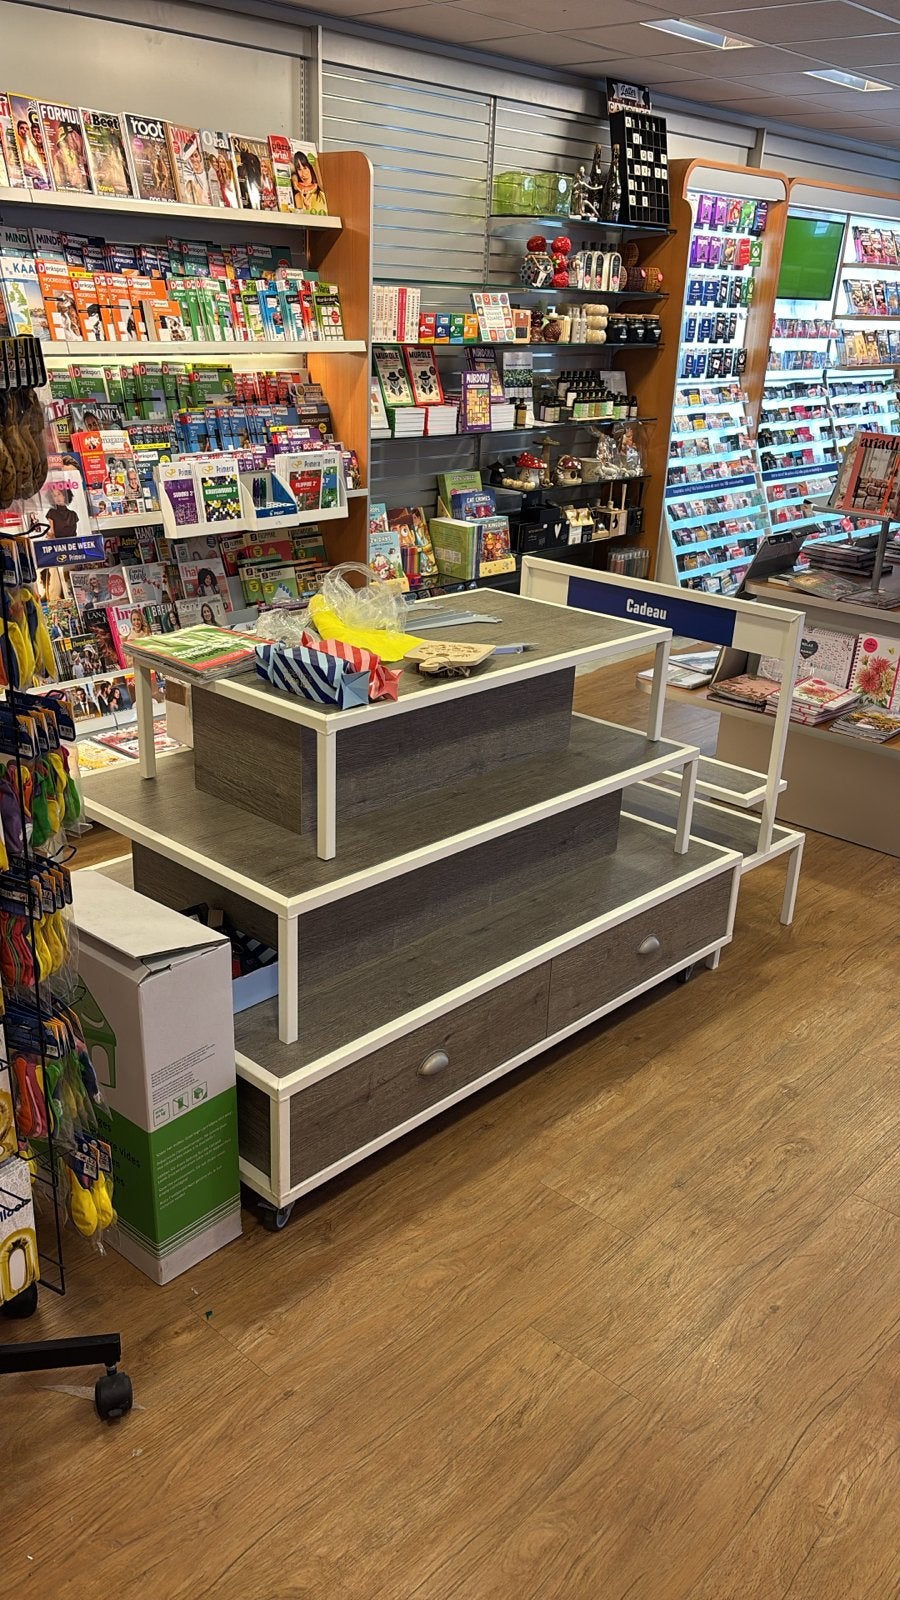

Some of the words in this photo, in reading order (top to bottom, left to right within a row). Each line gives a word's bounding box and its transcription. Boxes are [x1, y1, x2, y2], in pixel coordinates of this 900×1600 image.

[74, 366, 101, 377] Denksport
[57, 423, 67, 432] 137
[304, 459, 321, 468] Primera
[216, 465, 234, 474] Primera
[42, 546, 53, 554] TIP
[53, 544, 67, 553] VAN
[67, 543, 78, 551] DE
[77, 541, 96, 549] WEEK
[626, 598, 667, 621] Cadeau
